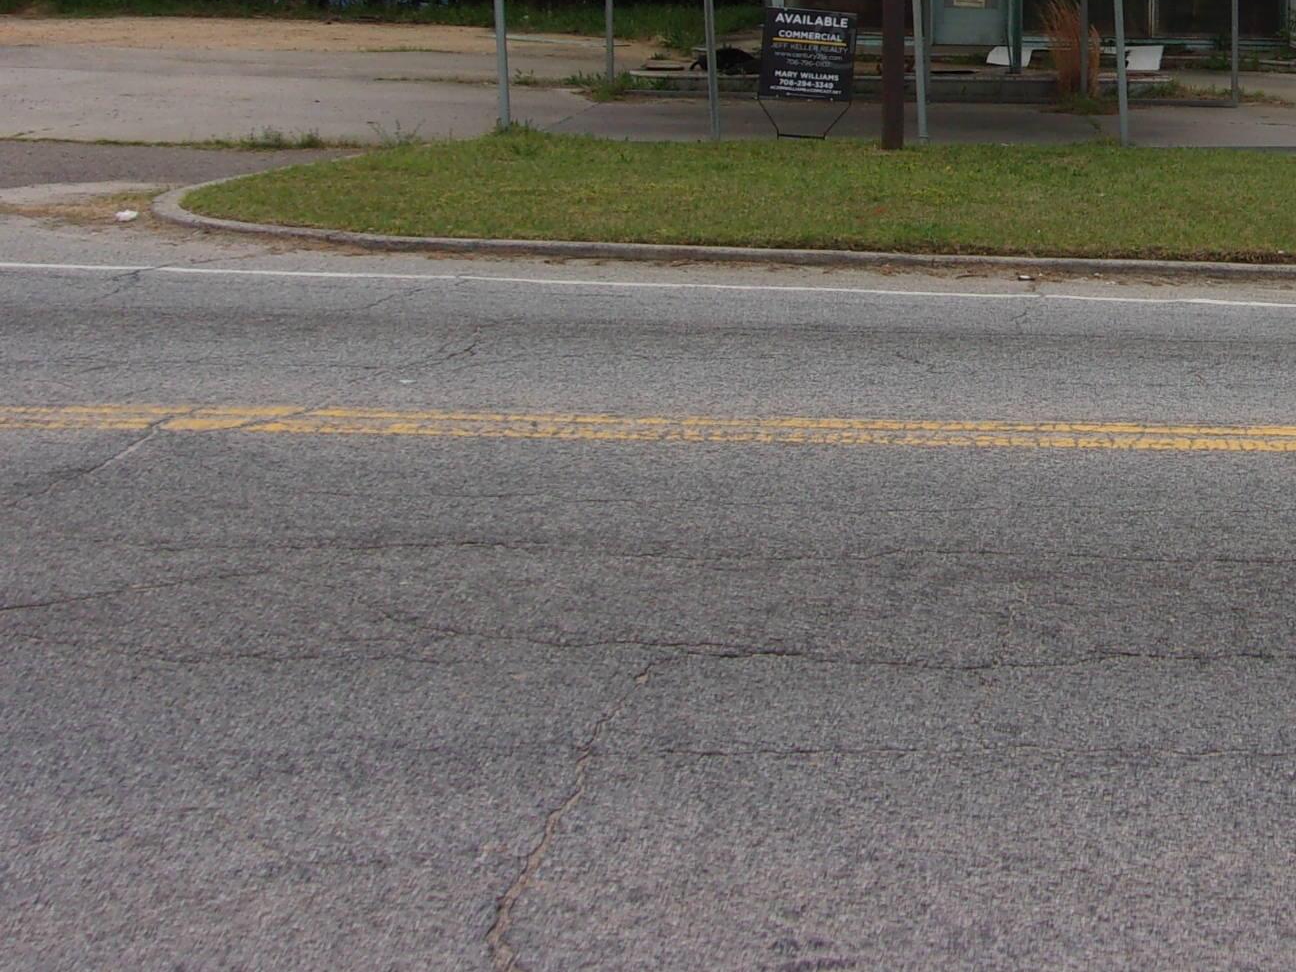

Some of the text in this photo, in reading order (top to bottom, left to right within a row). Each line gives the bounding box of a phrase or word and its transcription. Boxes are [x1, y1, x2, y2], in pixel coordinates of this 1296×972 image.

[775, 13, 848, 28] AVAILABLE
[778, 30, 842, 42] COMMERCIAL
[774, 69, 840, 81] MARY WILLIAMS
